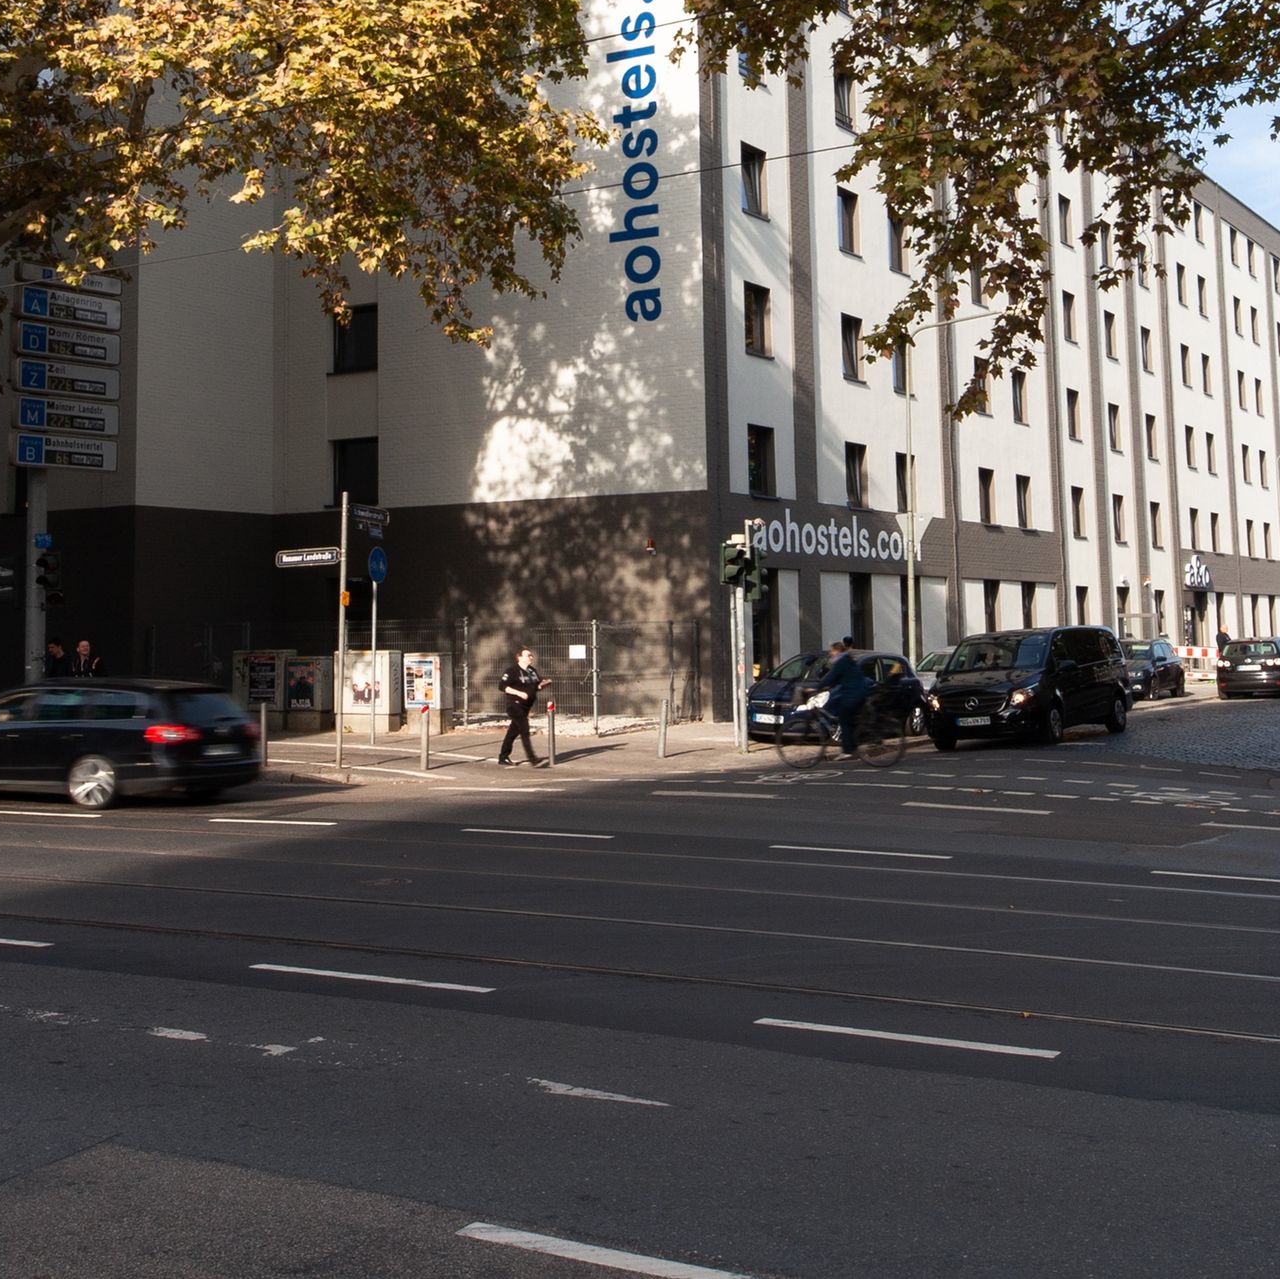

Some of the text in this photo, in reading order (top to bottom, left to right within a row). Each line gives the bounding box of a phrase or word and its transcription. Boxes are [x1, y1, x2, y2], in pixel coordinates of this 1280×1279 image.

[31, 298, 41, 314] A
[50, 292, 103, 310] Anlagenring
[29, 334, 40, 349] D
[48, 327, 106, 343] Dom/Römer
[48, 364, 66, 375] Zeil
[29, 371, 39, 387] Z
[47, 401, 76, 412] Mainzer
[26, 409, 39, 425] M
[45, 437, 103, 451] Bahnhofsviertel
[25, 446, 36, 462] B
